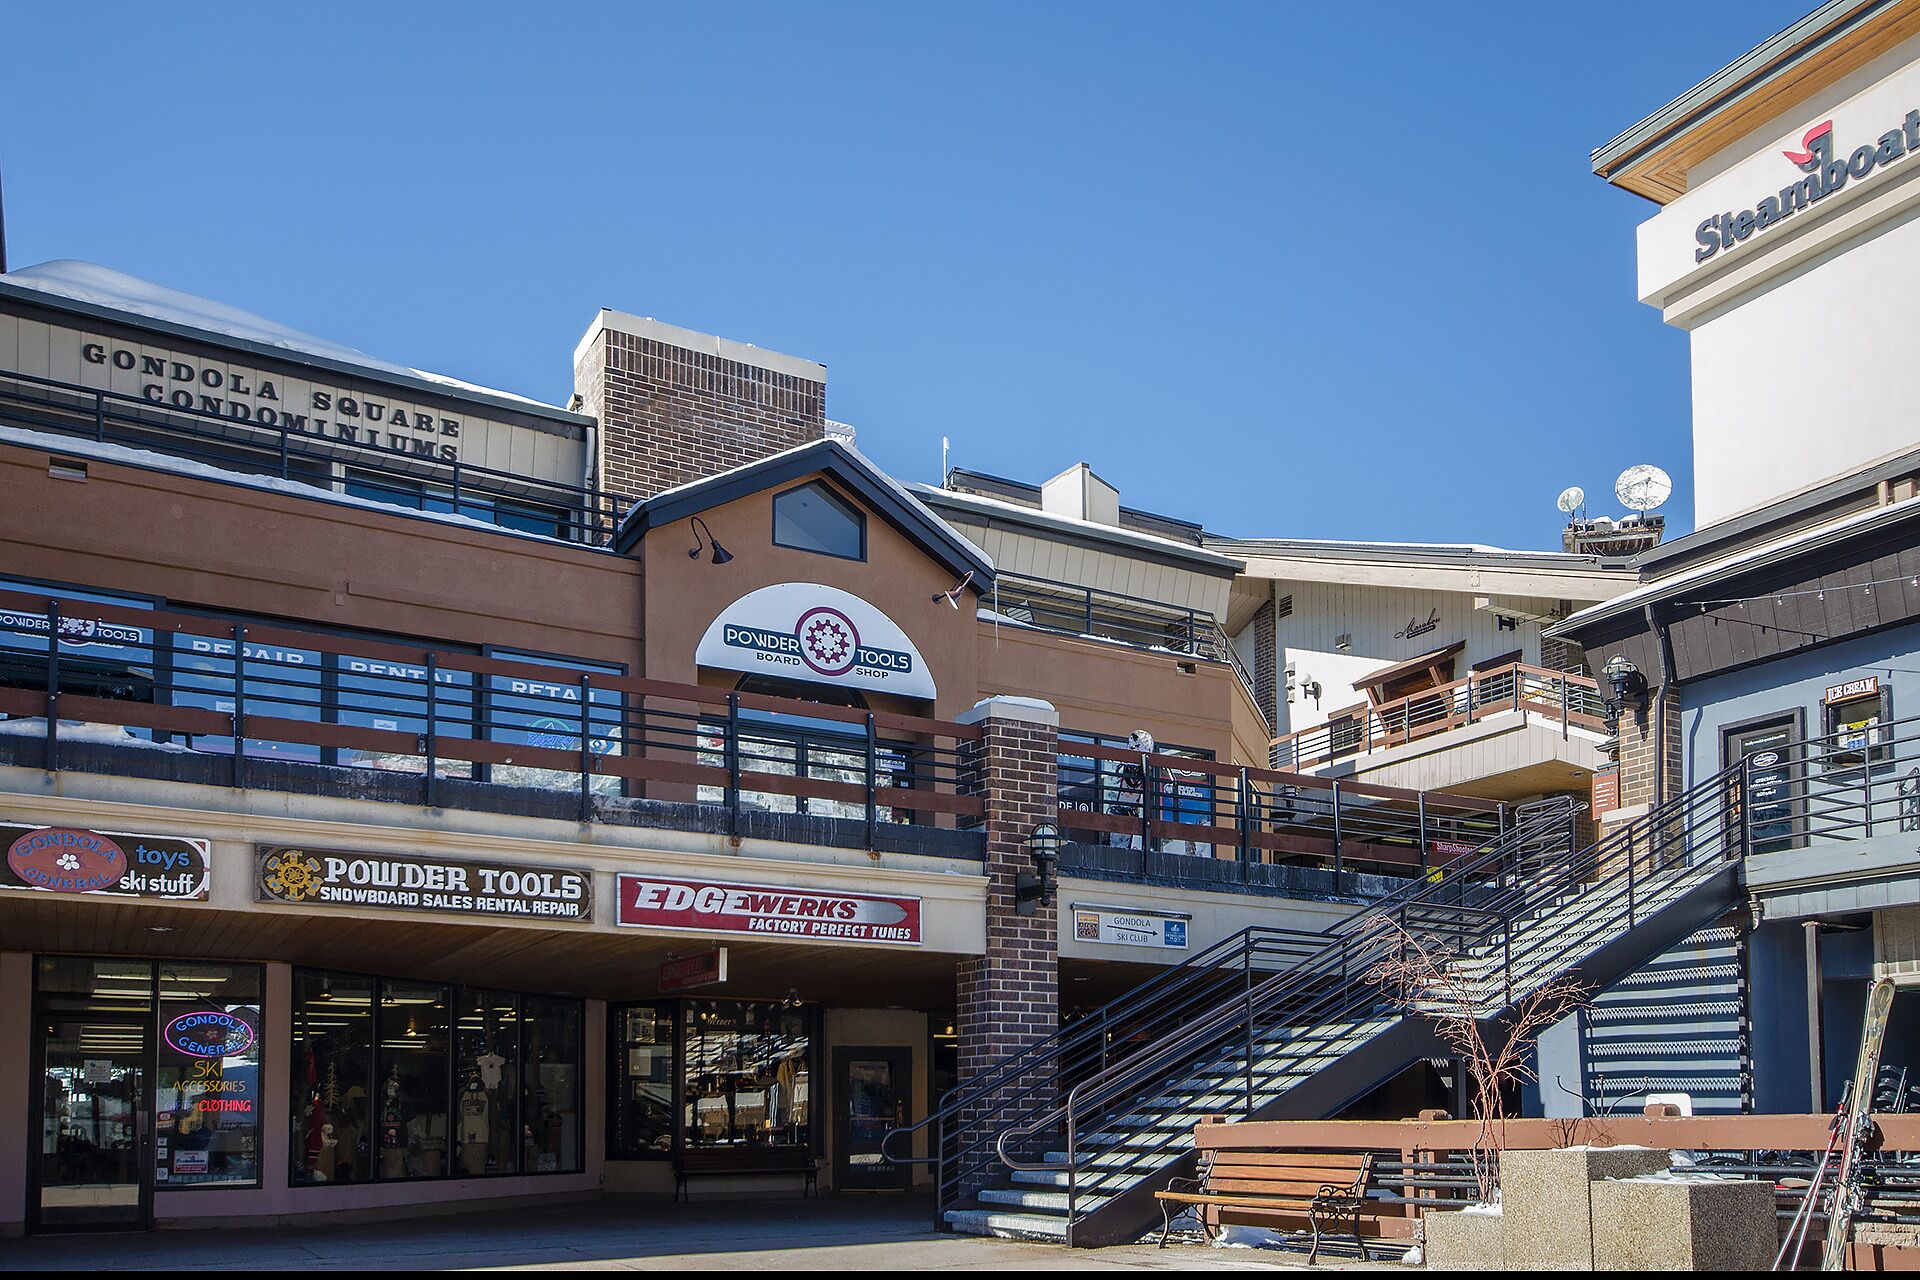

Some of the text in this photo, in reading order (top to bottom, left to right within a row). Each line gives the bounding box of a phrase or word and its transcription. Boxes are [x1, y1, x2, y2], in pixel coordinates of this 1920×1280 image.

[1695, 108, 1920, 265] Steamboat
[83, 343, 460, 438] GONDOLA SQUARE
[143, 384, 459, 463] CONDOMINIUMS
[96, 627, 138, 642] TOOLS
[727, 628, 909, 670] POWDER TOOLS
[756, 652, 889, 679] BOARD SHOP
[1827, 678, 1875, 702] ICE CREAM
[15, 832, 116, 863] GONDOLA
[136, 845, 190, 871] toys
[23, 867, 111, 889] GENERAL
[120, 870, 194, 894] ski stuff
[324, 857, 582, 900] POWDER TOOLS
[320, 886, 579, 917] SNOWBOARD SALES RENTAL REPAIR
[748, 917, 911, 940] FACTORY PERFECT TUNES
[1113, 916, 1151, 928] GONDOLA
[1116, 932, 1149, 943] SKI CLUB
[175, 1014, 246, 1033] GONDOLA
[178, 1036, 245, 1055] GENERAL
[192, 1060, 224, 1078] SKI
[172, 1080, 246, 1093] ACCESSORIES
[199, 1099, 251, 1113] CLOTHING
